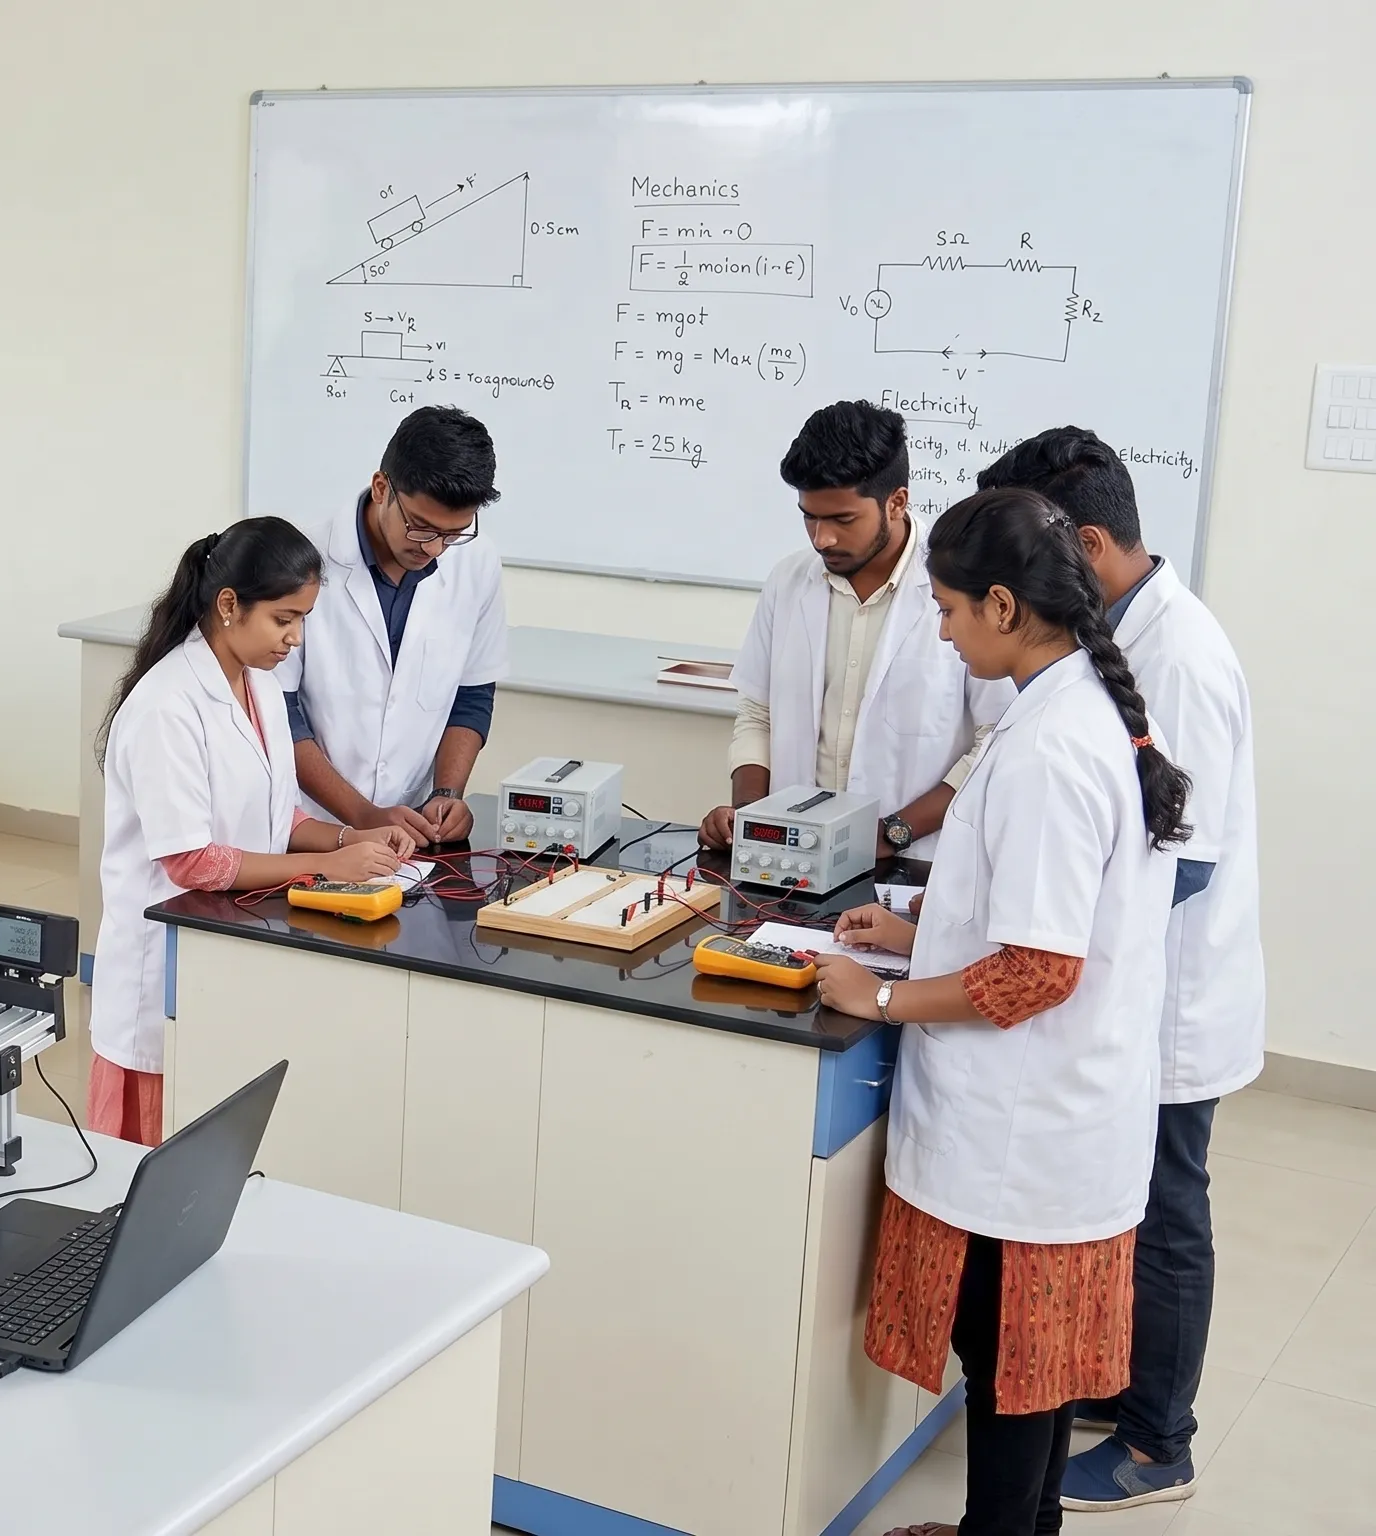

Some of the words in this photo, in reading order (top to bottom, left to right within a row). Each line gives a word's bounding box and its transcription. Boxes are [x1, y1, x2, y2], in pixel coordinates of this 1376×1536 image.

[632, 176, 738, 198] Mechanics
[642, 220, 654, 238] F
[1021, 232, 1033, 249] R
[640, 253, 653, 272] F
[617, 303, 630, 322] F
[615, 341, 627, 360] F
[657, 351, 683, 374] mg
[390, 390, 414, 403] Cat
[652, 434, 675, 452] 25
[681, 437, 703, 468] kg
[906, 436, 948, 459] icity,
